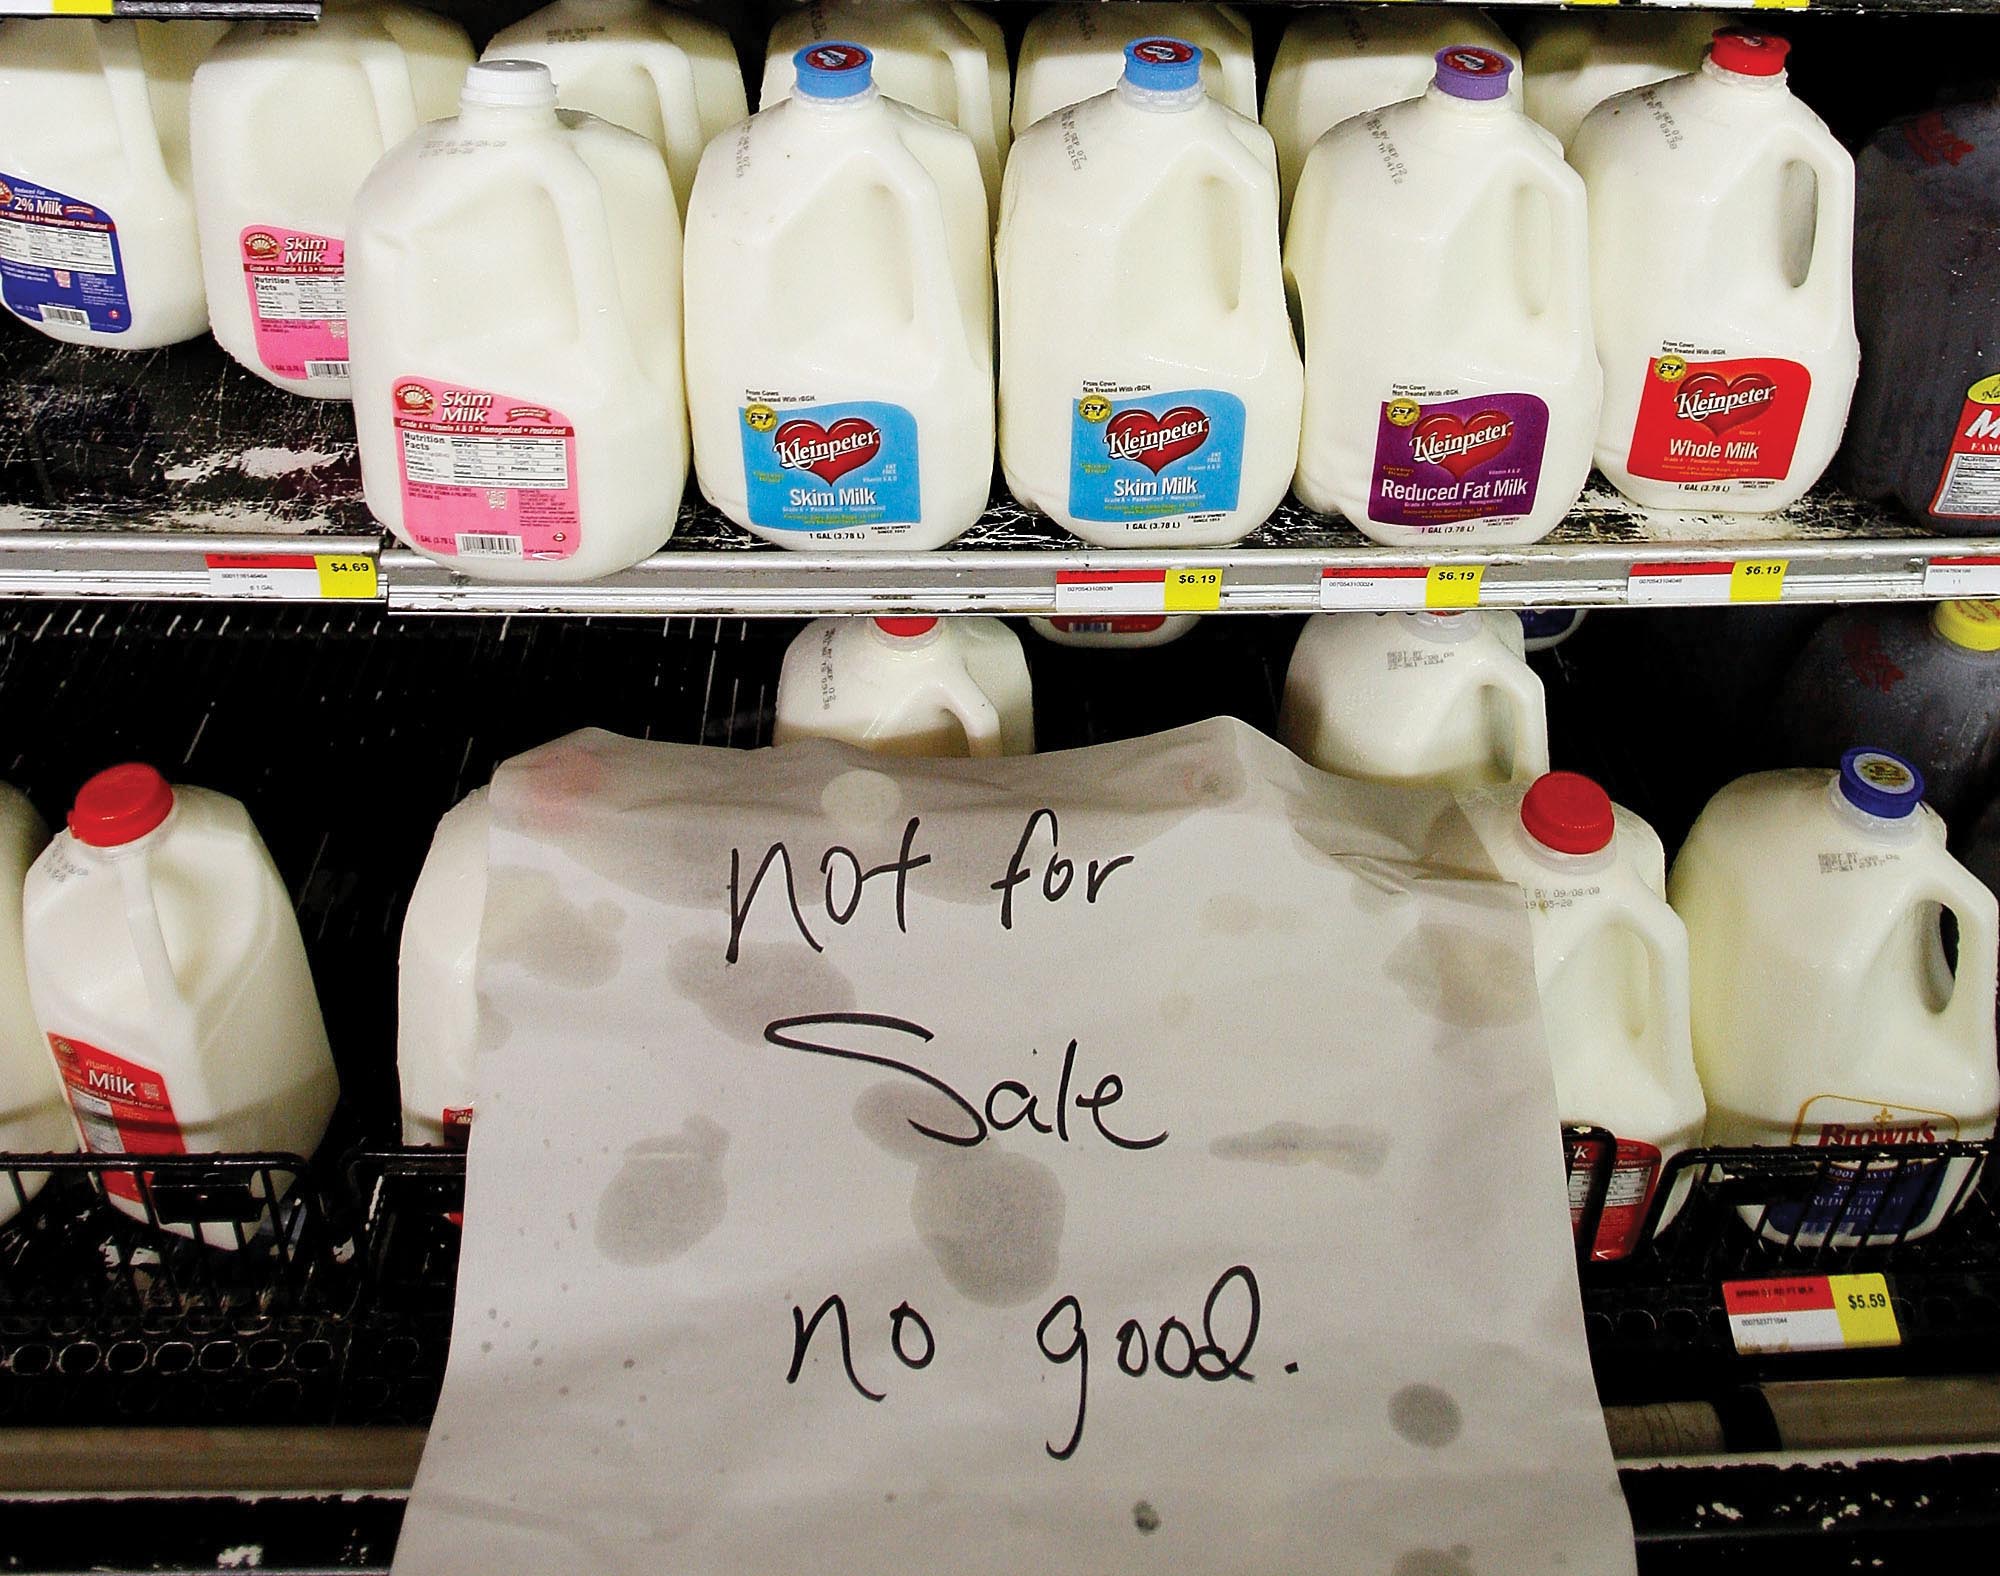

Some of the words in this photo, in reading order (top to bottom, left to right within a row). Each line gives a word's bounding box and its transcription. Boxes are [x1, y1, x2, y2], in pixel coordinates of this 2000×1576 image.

[14, 197, 35, 213] 2%
[36, 199, 63, 216] Milk
[284, 237, 328, 251] Skim
[285, 251, 324, 264] Milk
[254, 276, 290, 284] Nutrition
[255, 283, 278, 291] Facts
[440, 391, 493, 408] Skim
[1673, 385, 1777, 422] Kleinpeter
[441, 407, 488, 424] Milk
[404, 432, 445, 444] Nutrition
[405, 440, 430, 451] Facts
[1103, 417, 1211, 460] Kleinpeter
[1408, 421, 1515, 465] Kleinpeter
[774, 428, 881, 471] Kleinpeter
[1670, 438, 1722, 458] Whole
[1724, 441, 1760, 459] Milk
[1113, 479, 1158, 497] Skim
[1161, 476, 1198, 495] Milk
[1381, 478, 1460, 502] Reduced
[1462, 481, 1492, 499] Fat
[1493, 478, 1529, 498] Milk
[789, 488, 835, 507] Skim
[839, 488, 877, 507] Milk
[1172, 521, 1181, 529] L)
[1428, 526, 1443, 534] GAL
[1466, 525, 1475, 533] L)
[856, 532, 865, 540] L)
[330, 562, 369, 572] $4.69
[1745, 565, 1781, 576] $6.19
[1178, 574, 1217, 584] $6.19
[1437, 571, 1475, 581] $6.19
[991, 808, 1135, 930] for
[88, 1069, 137, 1097] Milk
[764, 1012, 1169, 1150] Sale
[1818, 1120, 1937, 1147] Brown's
[1847, 1293, 1887, 1310] $5.59
[786, 1295, 935, 1402] no
[1037, 1266, 1299, 1460] good.
